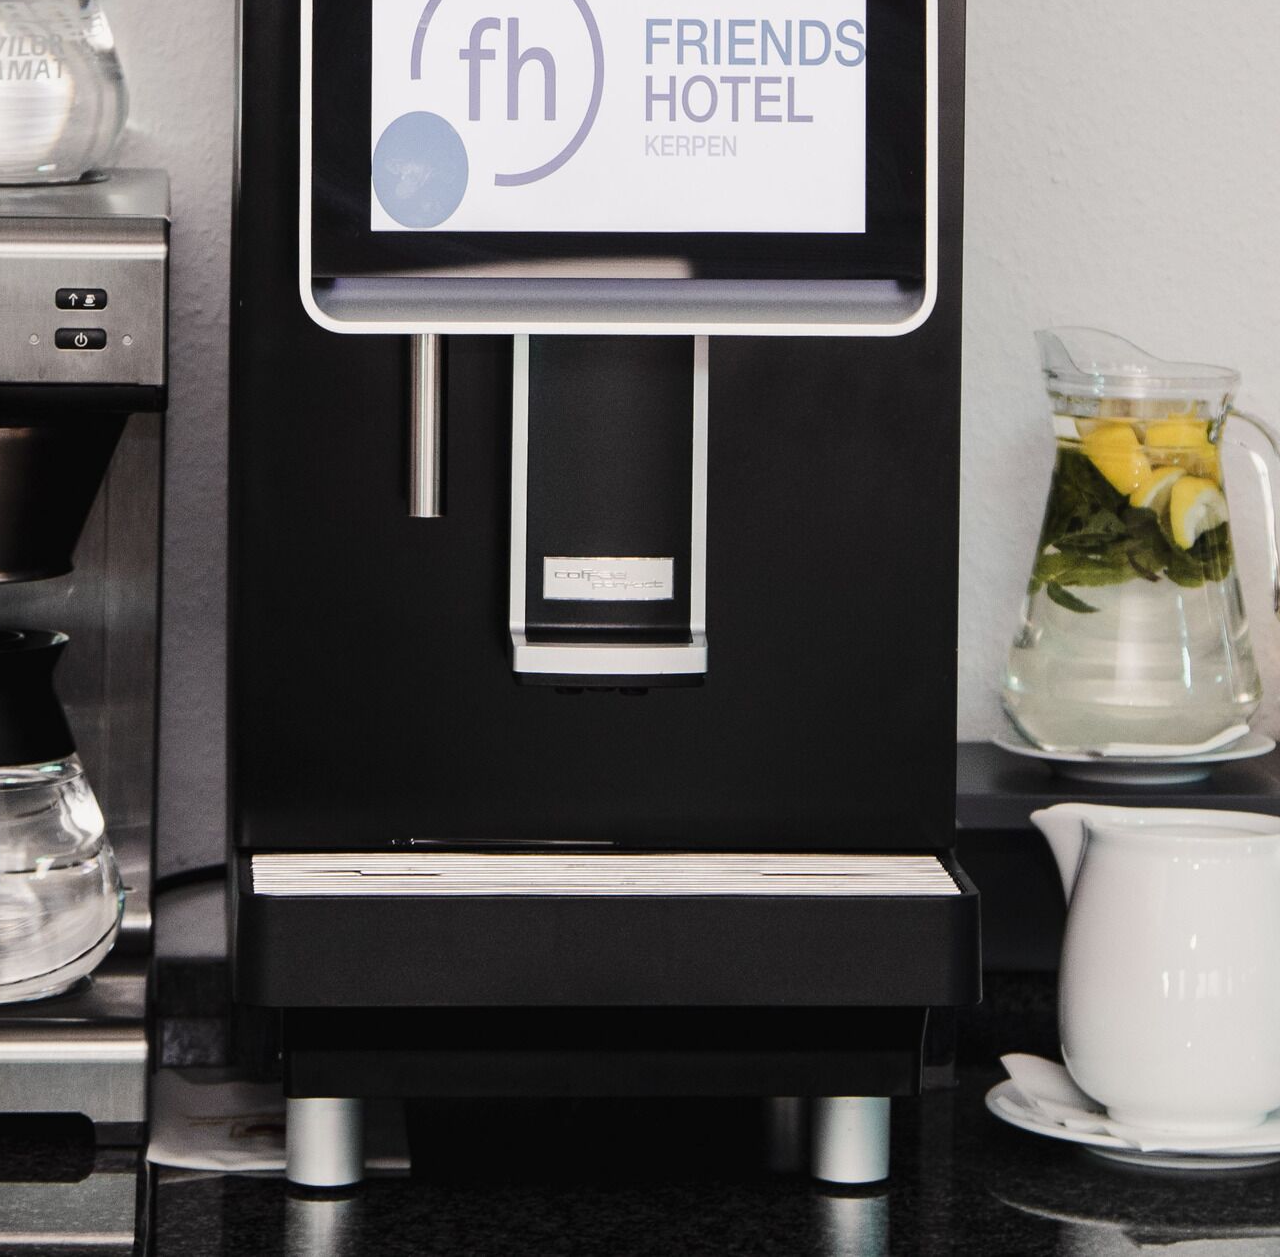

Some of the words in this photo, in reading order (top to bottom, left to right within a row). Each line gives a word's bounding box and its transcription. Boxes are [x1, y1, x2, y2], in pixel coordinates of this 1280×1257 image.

[645, 18, 866, 67] FRIENDS
[459, 17, 557, 121] fh
[645, 75, 814, 123] HOTEL
[645, 135, 738, 157] KERPEN
